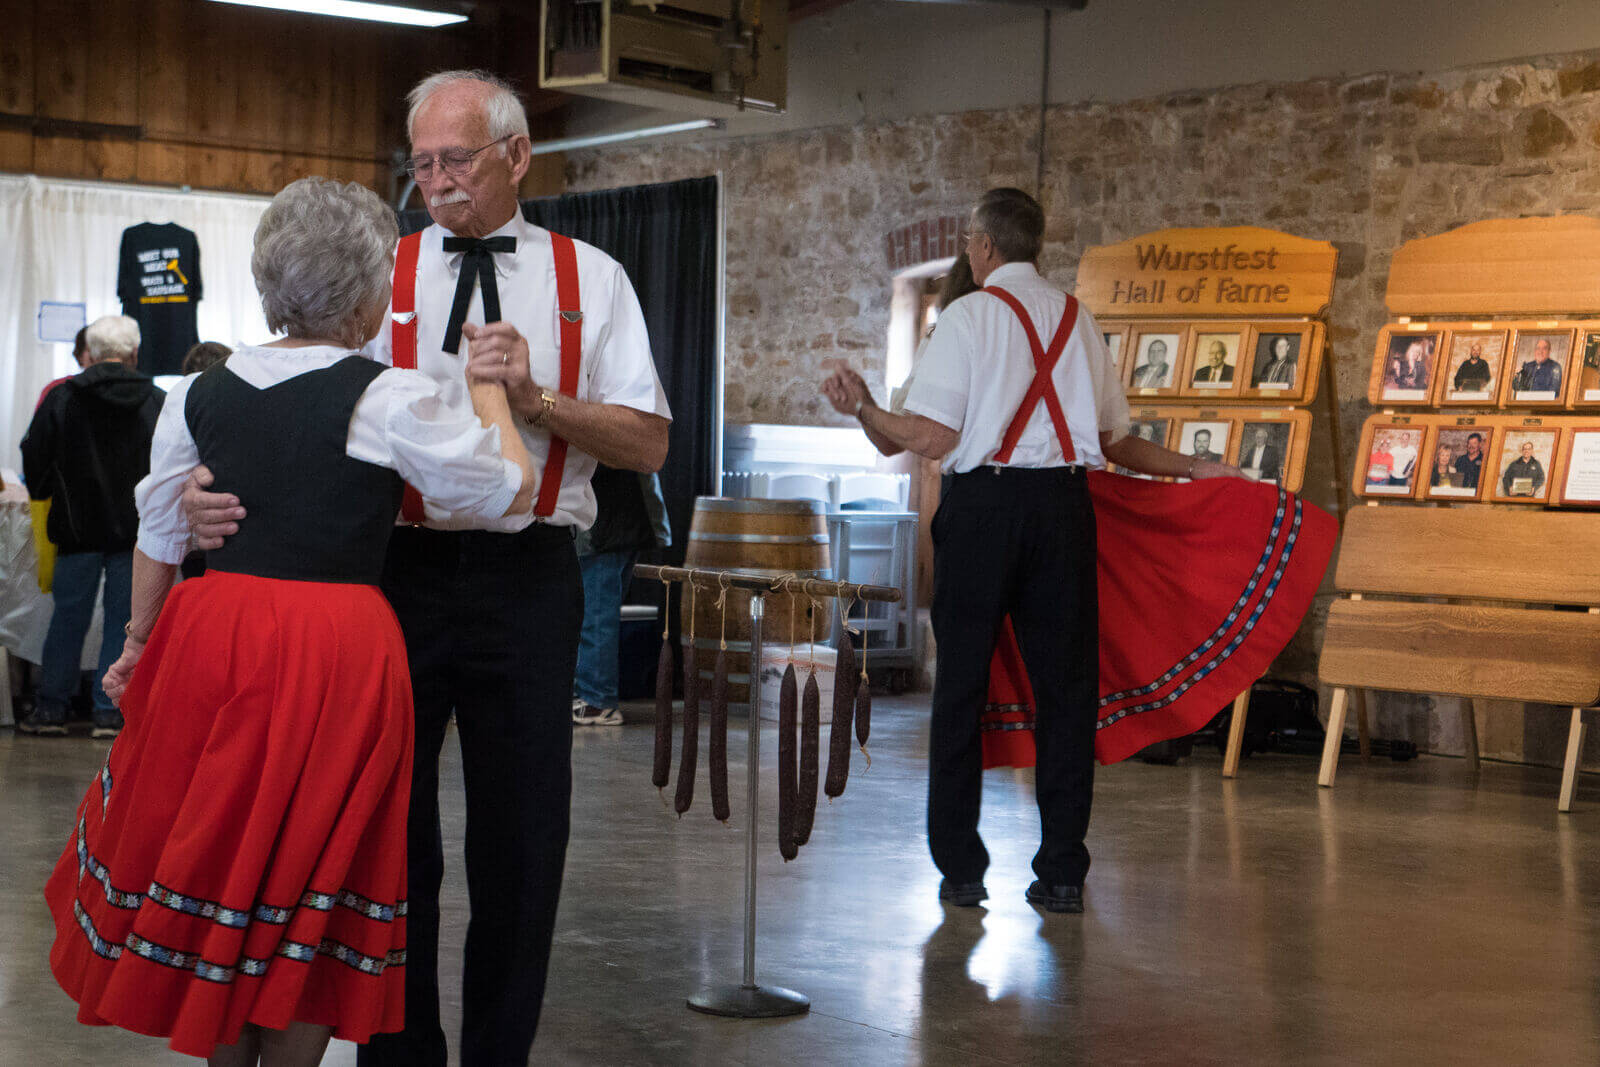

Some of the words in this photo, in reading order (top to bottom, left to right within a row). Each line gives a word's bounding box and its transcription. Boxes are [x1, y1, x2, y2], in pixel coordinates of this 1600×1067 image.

[1135, 245, 1278, 271] Wurstfest
[1110, 279, 1166, 304] Hall
[1176, 277, 1208, 304] of
[1216, 277, 1290, 304] Fame
